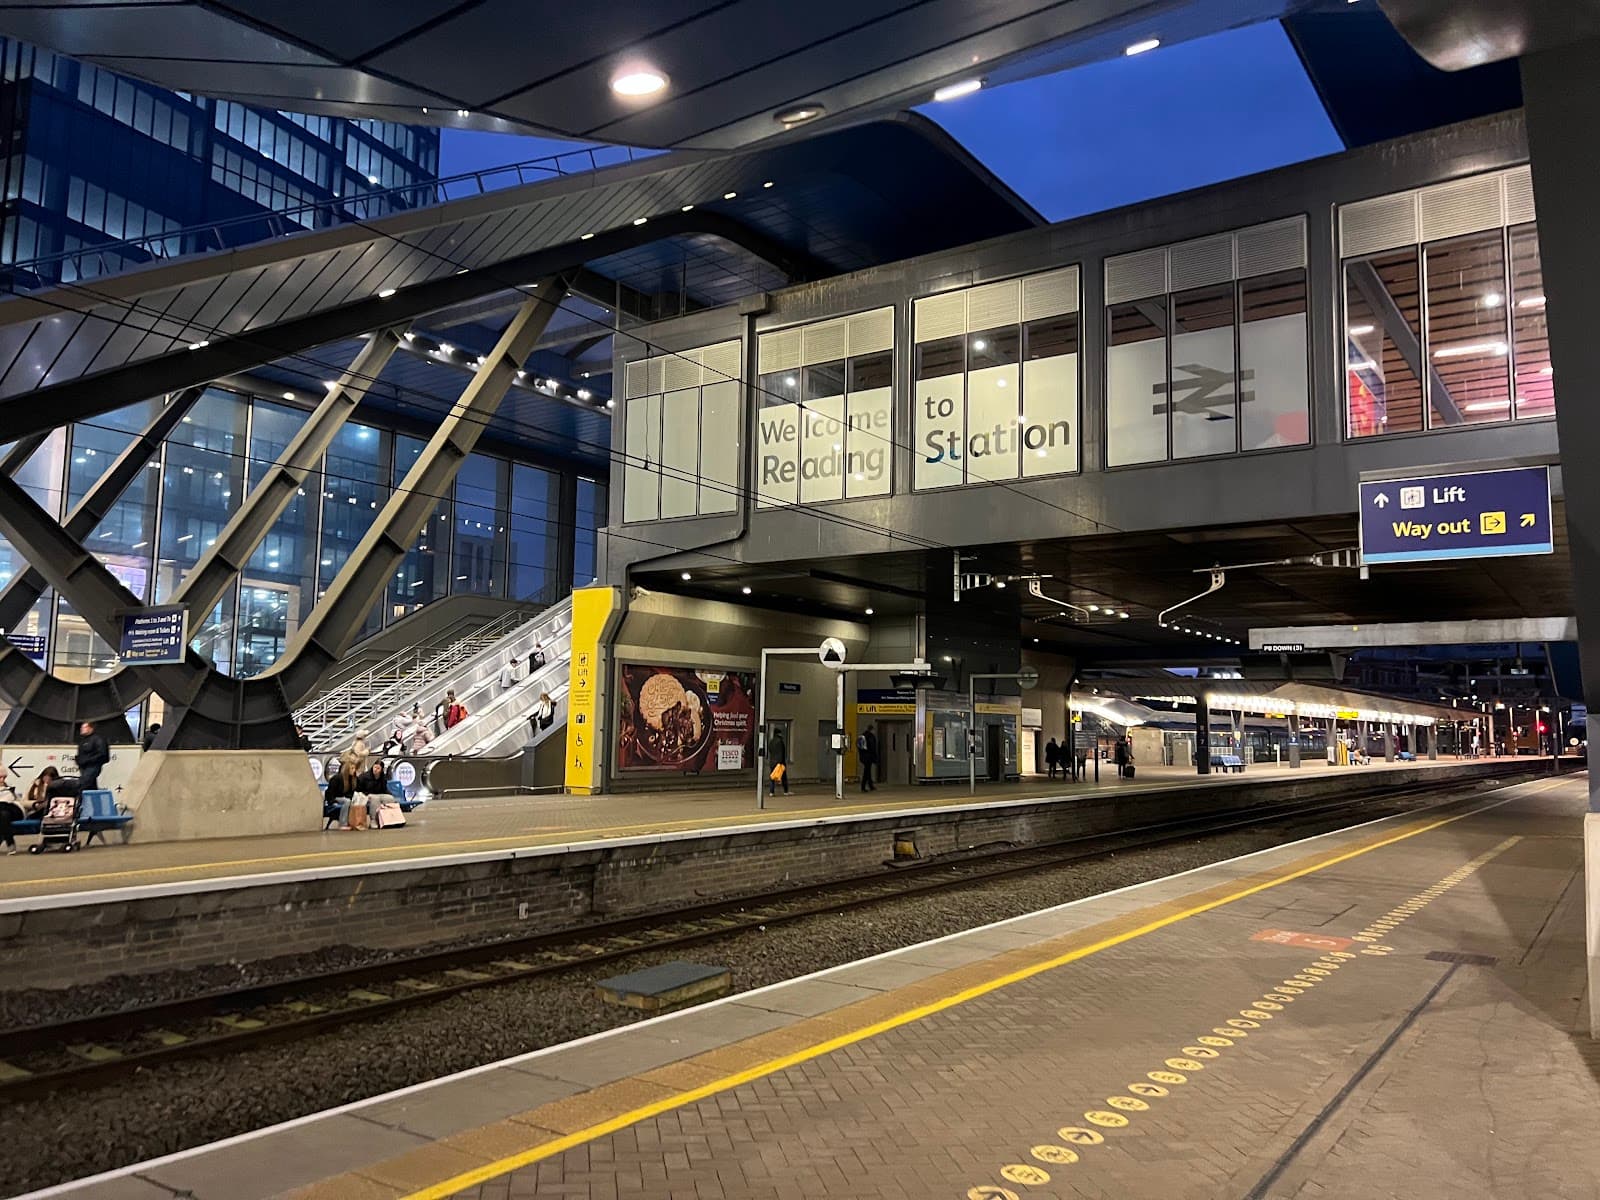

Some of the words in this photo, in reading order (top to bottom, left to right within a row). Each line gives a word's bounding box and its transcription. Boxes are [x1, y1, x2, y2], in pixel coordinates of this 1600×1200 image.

[761, 408, 888, 445] Welcome
[924, 396, 954, 419] to
[763, 447, 886, 485] Reading
[925, 418, 1070, 464] Station
[1433, 486, 1466, 505] Lift
[1392, 519, 1433, 540] Way
[1437, 517, 1471, 534] out
[713, 719, 736, 727] Christmas
[1089, 1112, 1122, 1125] Lift
[1005, 1166, 1044, 1182] Lift
